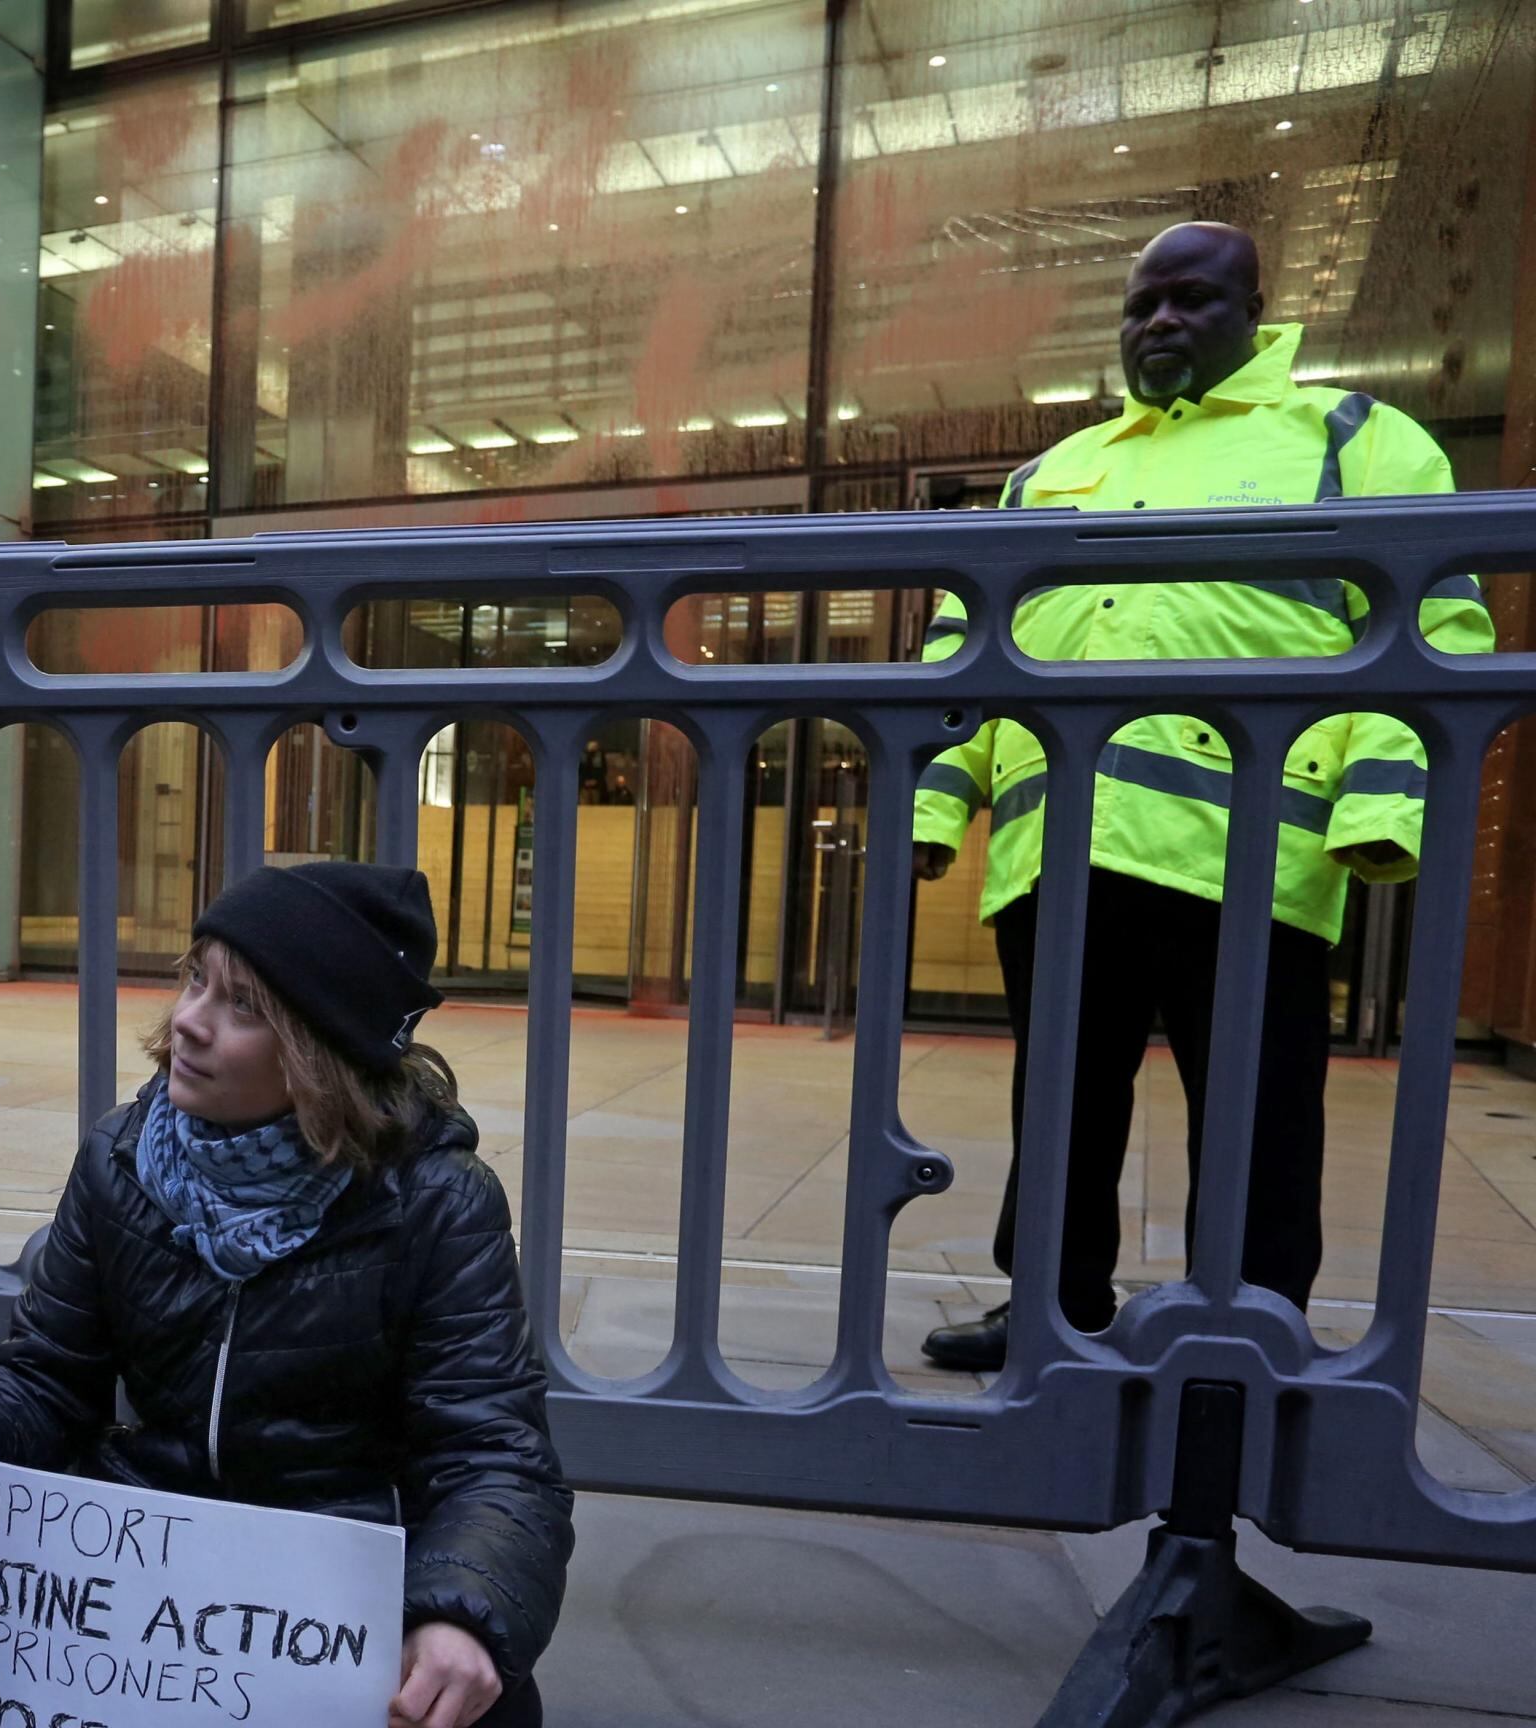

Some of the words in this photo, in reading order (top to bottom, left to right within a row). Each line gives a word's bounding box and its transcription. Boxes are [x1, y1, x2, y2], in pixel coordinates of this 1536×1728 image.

[1239, 480, 1257, 491] 30
[1207, 493, 1283, 506] Fenchurch
[140, 1595, 368, 1668] ACTION
